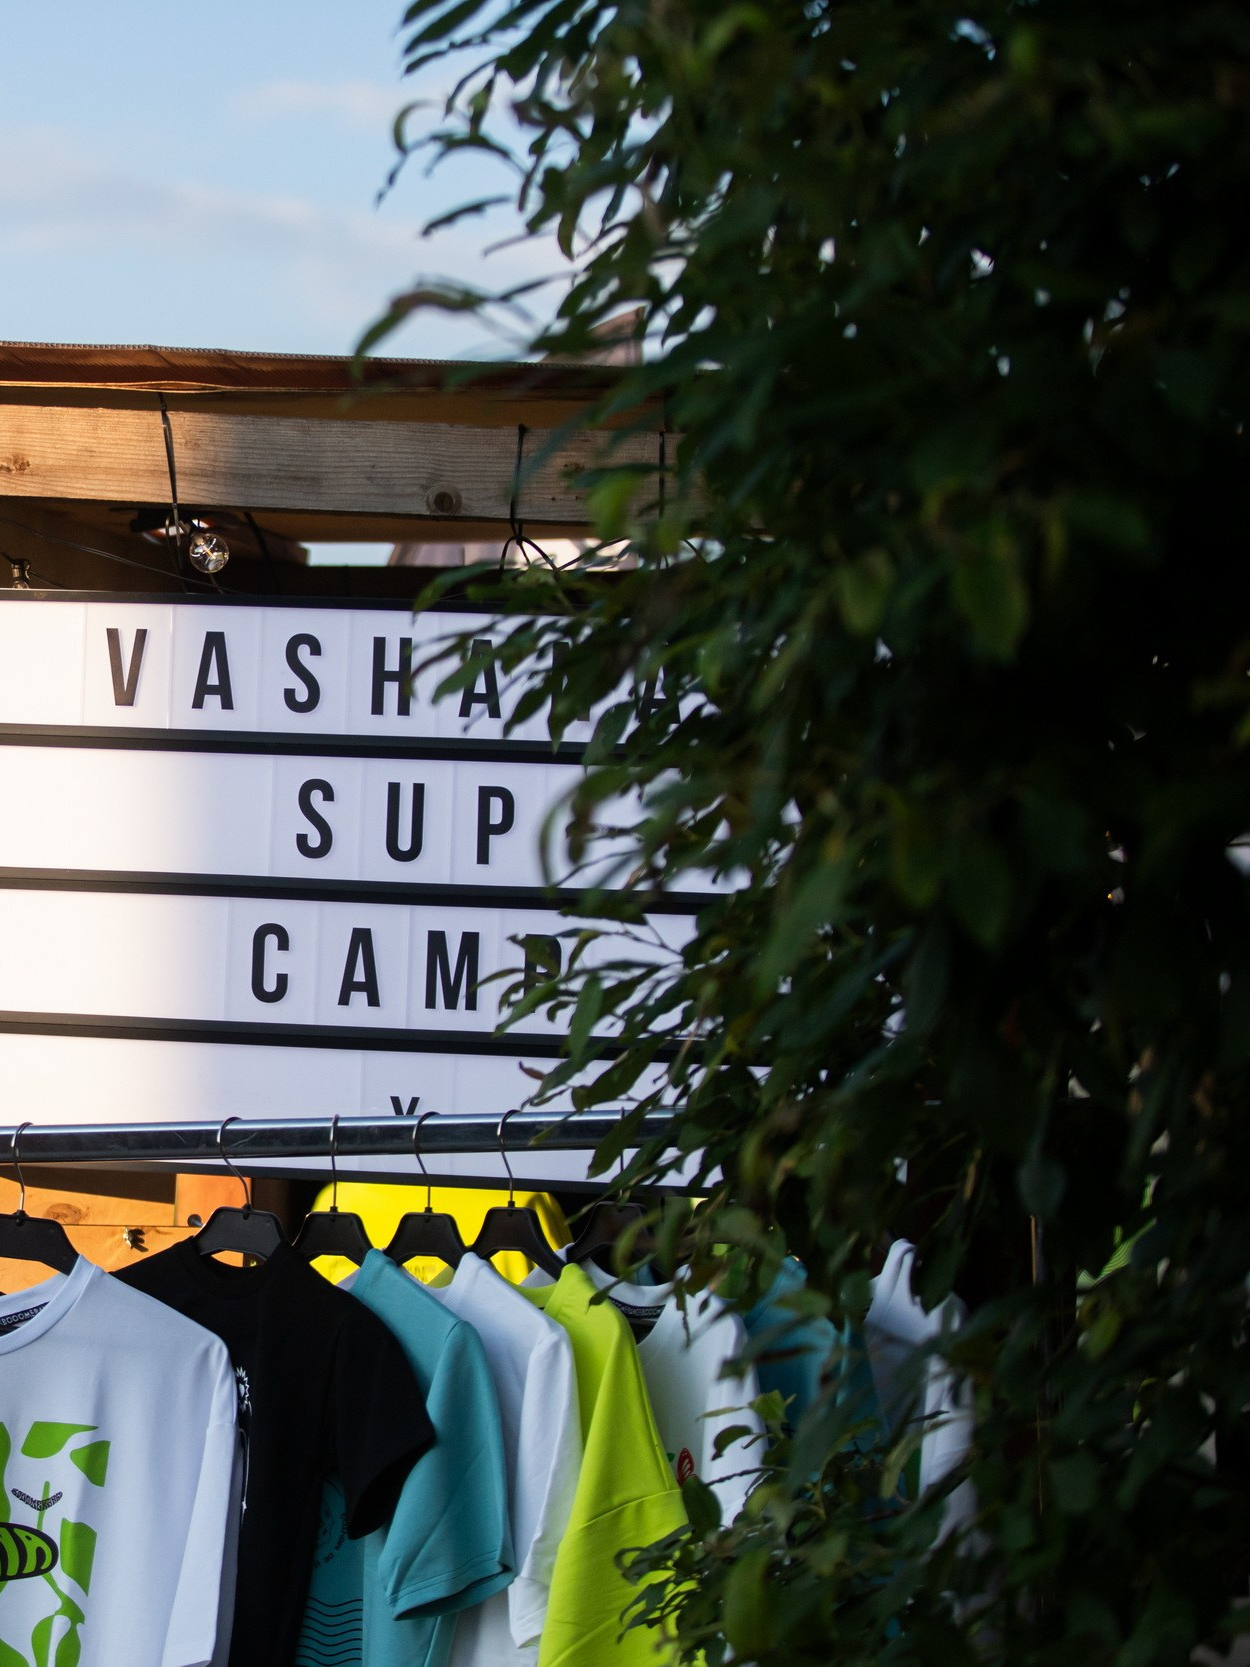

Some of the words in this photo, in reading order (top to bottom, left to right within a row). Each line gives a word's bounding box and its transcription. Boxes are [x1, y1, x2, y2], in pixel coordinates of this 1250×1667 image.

[106, 626, 682, 726] VASHAA
[296, 778, 515, 865] SUP
[251, 922, 562, 1013] CAMP
